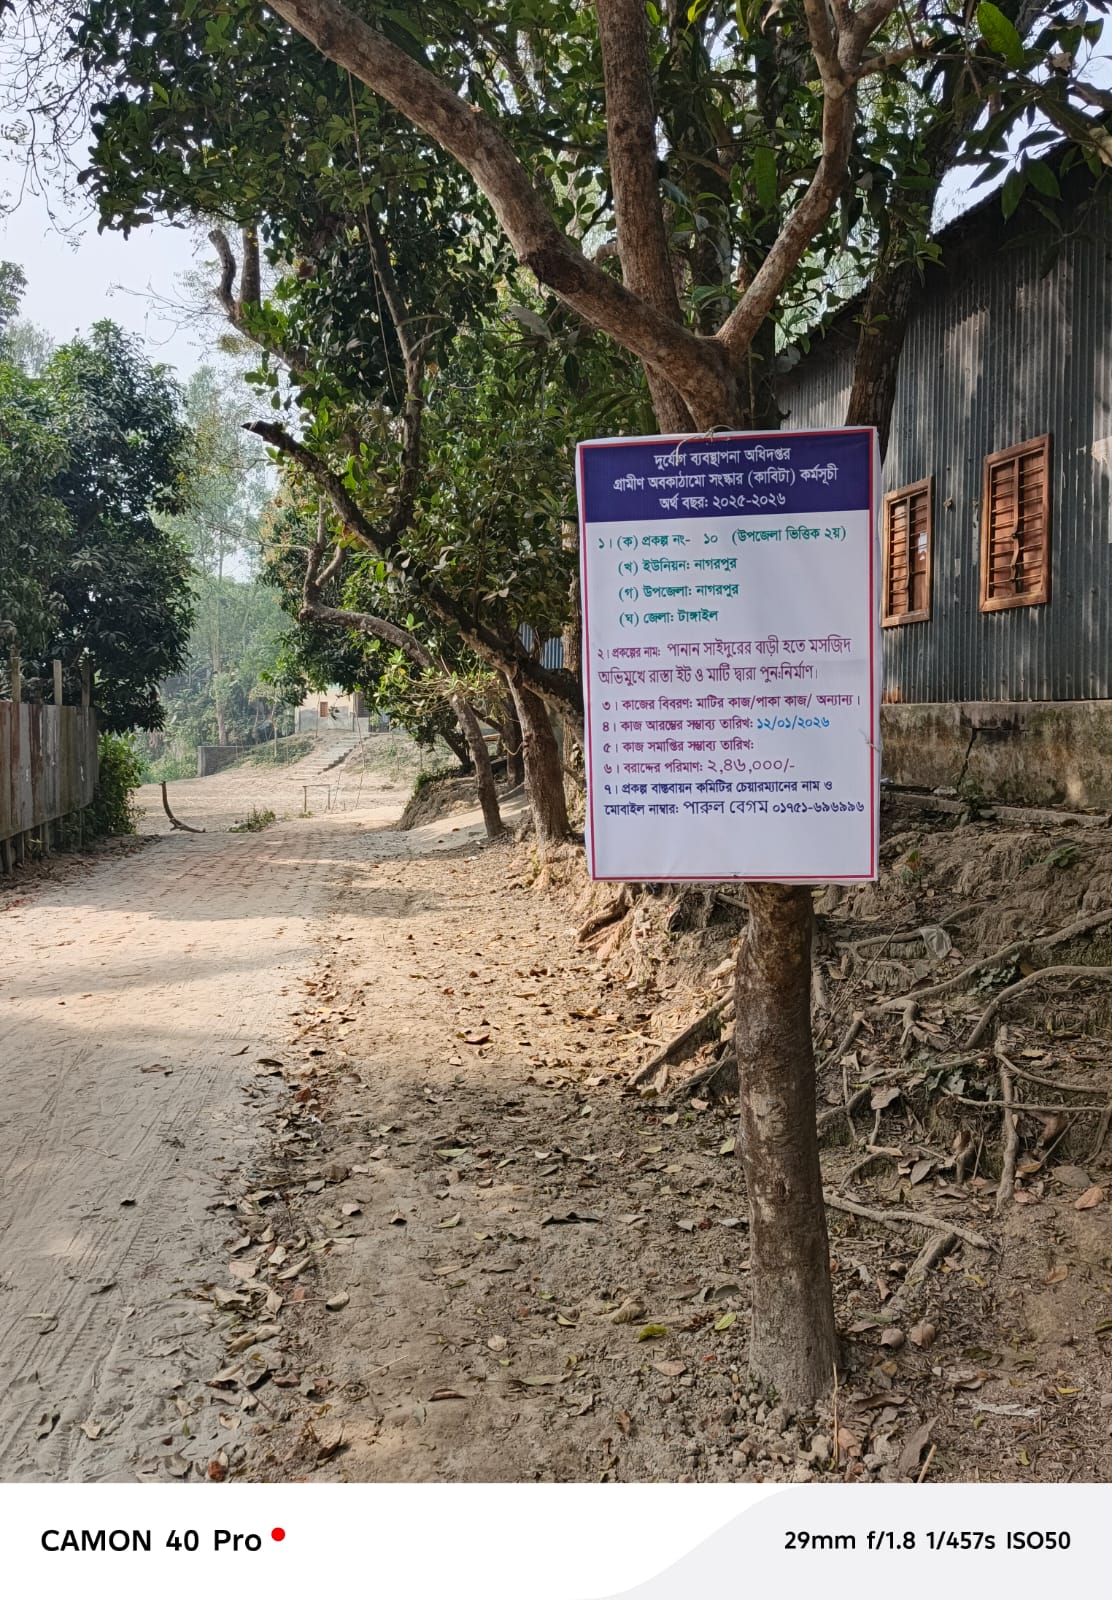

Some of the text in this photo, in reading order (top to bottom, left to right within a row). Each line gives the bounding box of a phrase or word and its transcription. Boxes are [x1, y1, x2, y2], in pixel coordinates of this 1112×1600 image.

[691, 452, 740, 468] ব্যবস্থাপনা
[744, 446, 791, 462] অধিদপ্তর
[614, 463, 839, 492] গ্রামীণ অবকাঠামো সংস্কার (কাবিটা) কর্মসূচী
[660, 496, 679, 510] অর্থ
[713, 493, 786, 510] ২০২৫-২০২৬
[617, 536, 638, 550] (ক)
[642, 534, 668, 547] প্রকল্প
[704, 533, 718, 544] ১০
[732, 527, 782, 546] (উপজেলা
[786, 526, 820, 540] ভিত্তিক
[824, 526, 846, 541] ২য়)
[618, 560, 638, 576] (খ)
[694, 558, 737, 572] নাগরপুর
[619, 587, 639, 601] (গ)
[696, 583, 739, 596] নাগরপুর
[619, 612, 639, 627] (ঘ)
[678, 608, 719, 622] টাঙ্গাইল
[612, 647, 641, 659] প্রকল্পের
[667, 642, 700, 657] পানান
[703, 638, 751, 658] সাইদুরের
[755, 635, 779, 657] বাড়ী
[782, 640, 806, 653] হতে
[809, 634, 852, 654] মসজিদ
[598, 666, 646, 687] অভিমুখে
[649, 669, 673, 682] রাস্তা
[676, 665, 692, 682] ইট
[695, 668, 703, 682] ও
[708, 663, 730, 682] মাটি
[734, 667, 756, 683] দ্বারা
[622, 699, 655, 710] কাজের
[696, 694, 724, 708] মাটির
[620, 720, 642, 732] কাজ
[756, 716, 830, 730] ১২/০১/২০২৬
[622, 742, 644, 752] কাজ
[648, 738, 684, 752] সমাপ্তির
[623, 762, 660, 774] বরাদ্দের
[622, 783, 647, 794] প্রকল্প
[696, 779, 732, 793] কমিটির
[736, 781, 798, 793] চেয়ারম্যানের
[802, 781, 820, 791] নাম
[824, 781, 832, 791] ও
[604, 802, 644, 816] মোবাইল
[683, 800, 724, 816] পারুল
[729, 800, 769, 814] বেগম
[772, 802, 864, 814] ০১৭৫১-৬৯৬৯৯৬
